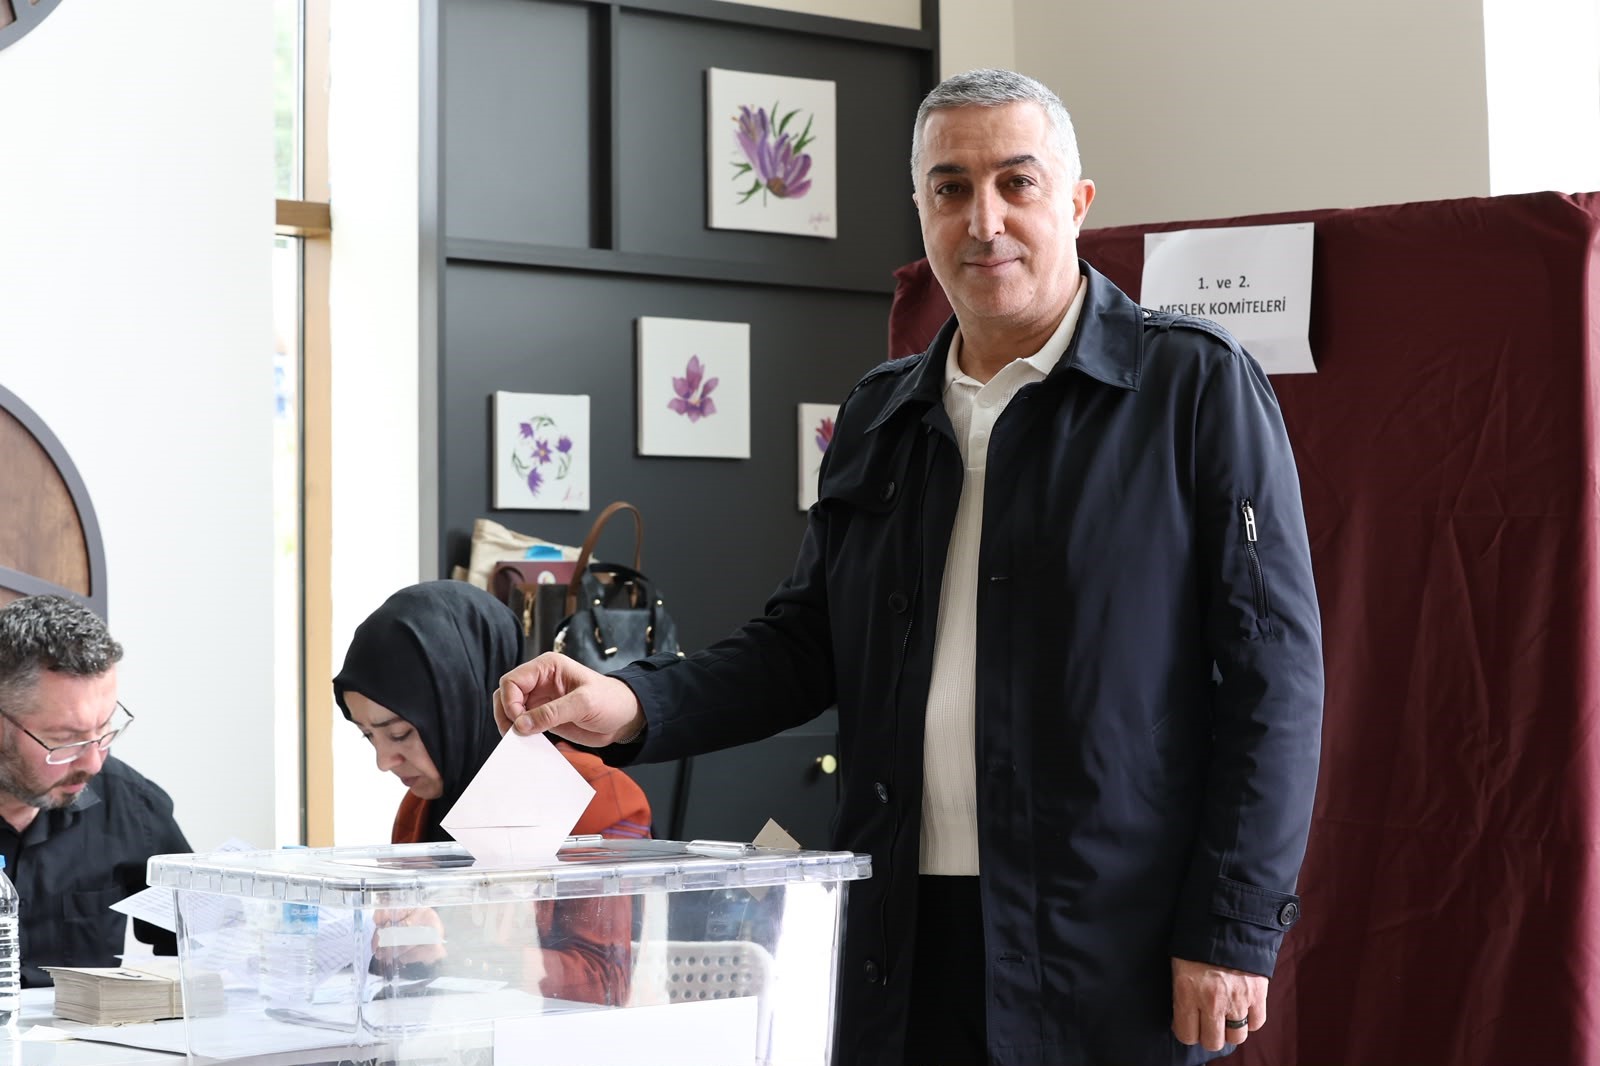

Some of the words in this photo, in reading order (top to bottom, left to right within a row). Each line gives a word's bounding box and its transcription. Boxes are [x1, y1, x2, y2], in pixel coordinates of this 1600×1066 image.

[1198, 277, 1209, 290] 1.
[1216, 278, 1232, 289] ve
[1238, 275, 1250, 288] 2.
[1159, 302, 1206, 316] MESLEK
[1209, 296, 1286, 316] KOMİTELERİ
